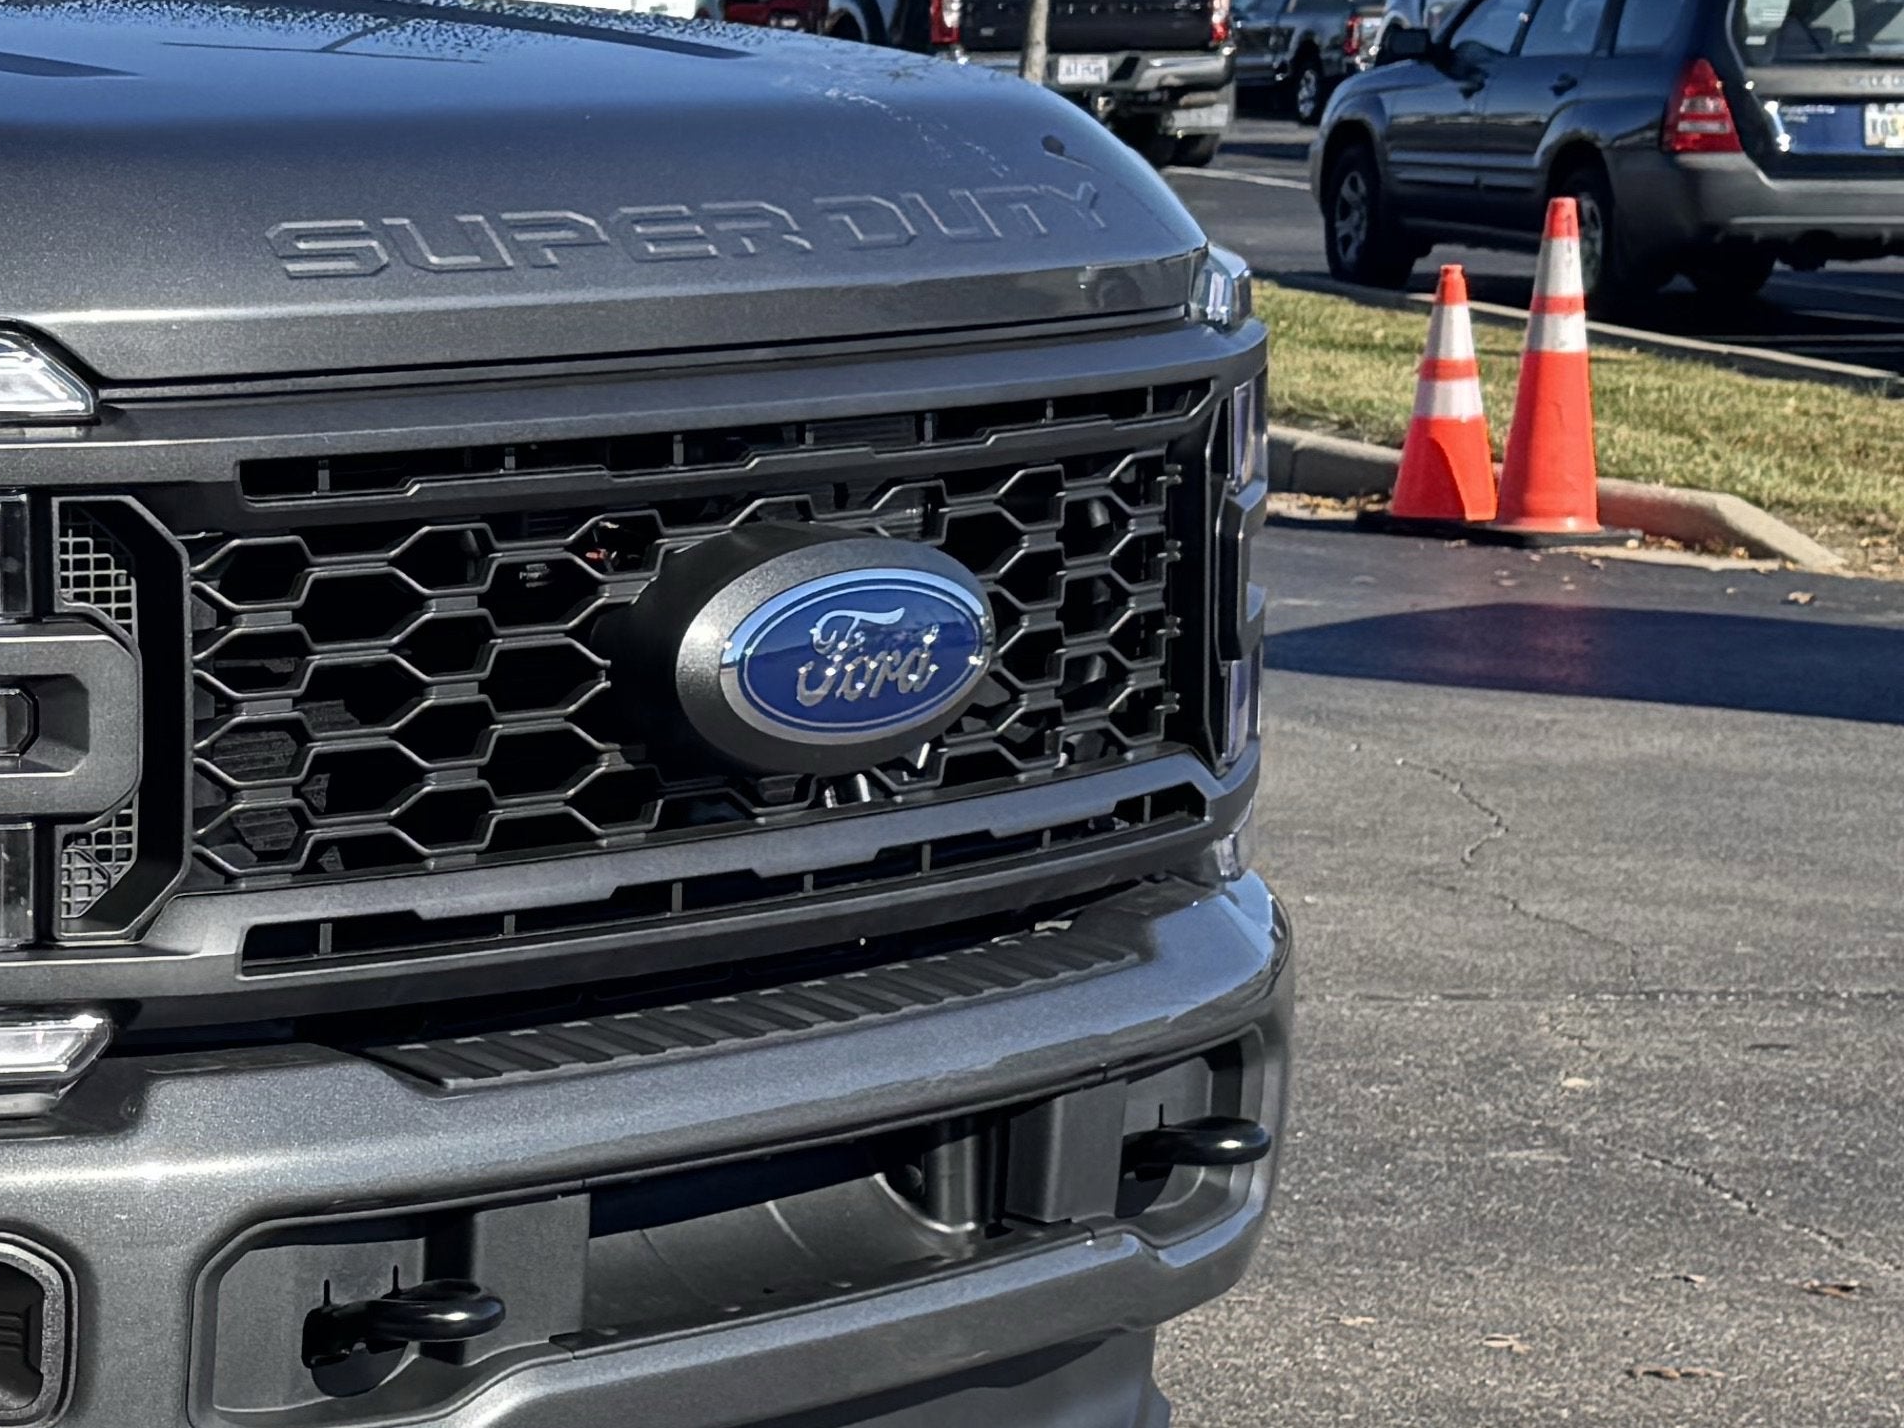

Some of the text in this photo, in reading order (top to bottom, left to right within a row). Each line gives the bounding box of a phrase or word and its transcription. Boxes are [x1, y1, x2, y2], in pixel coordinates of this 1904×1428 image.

[264, 183, 1107, 278] SUPER DUTY
[796, 606, 939, 708] Ford
